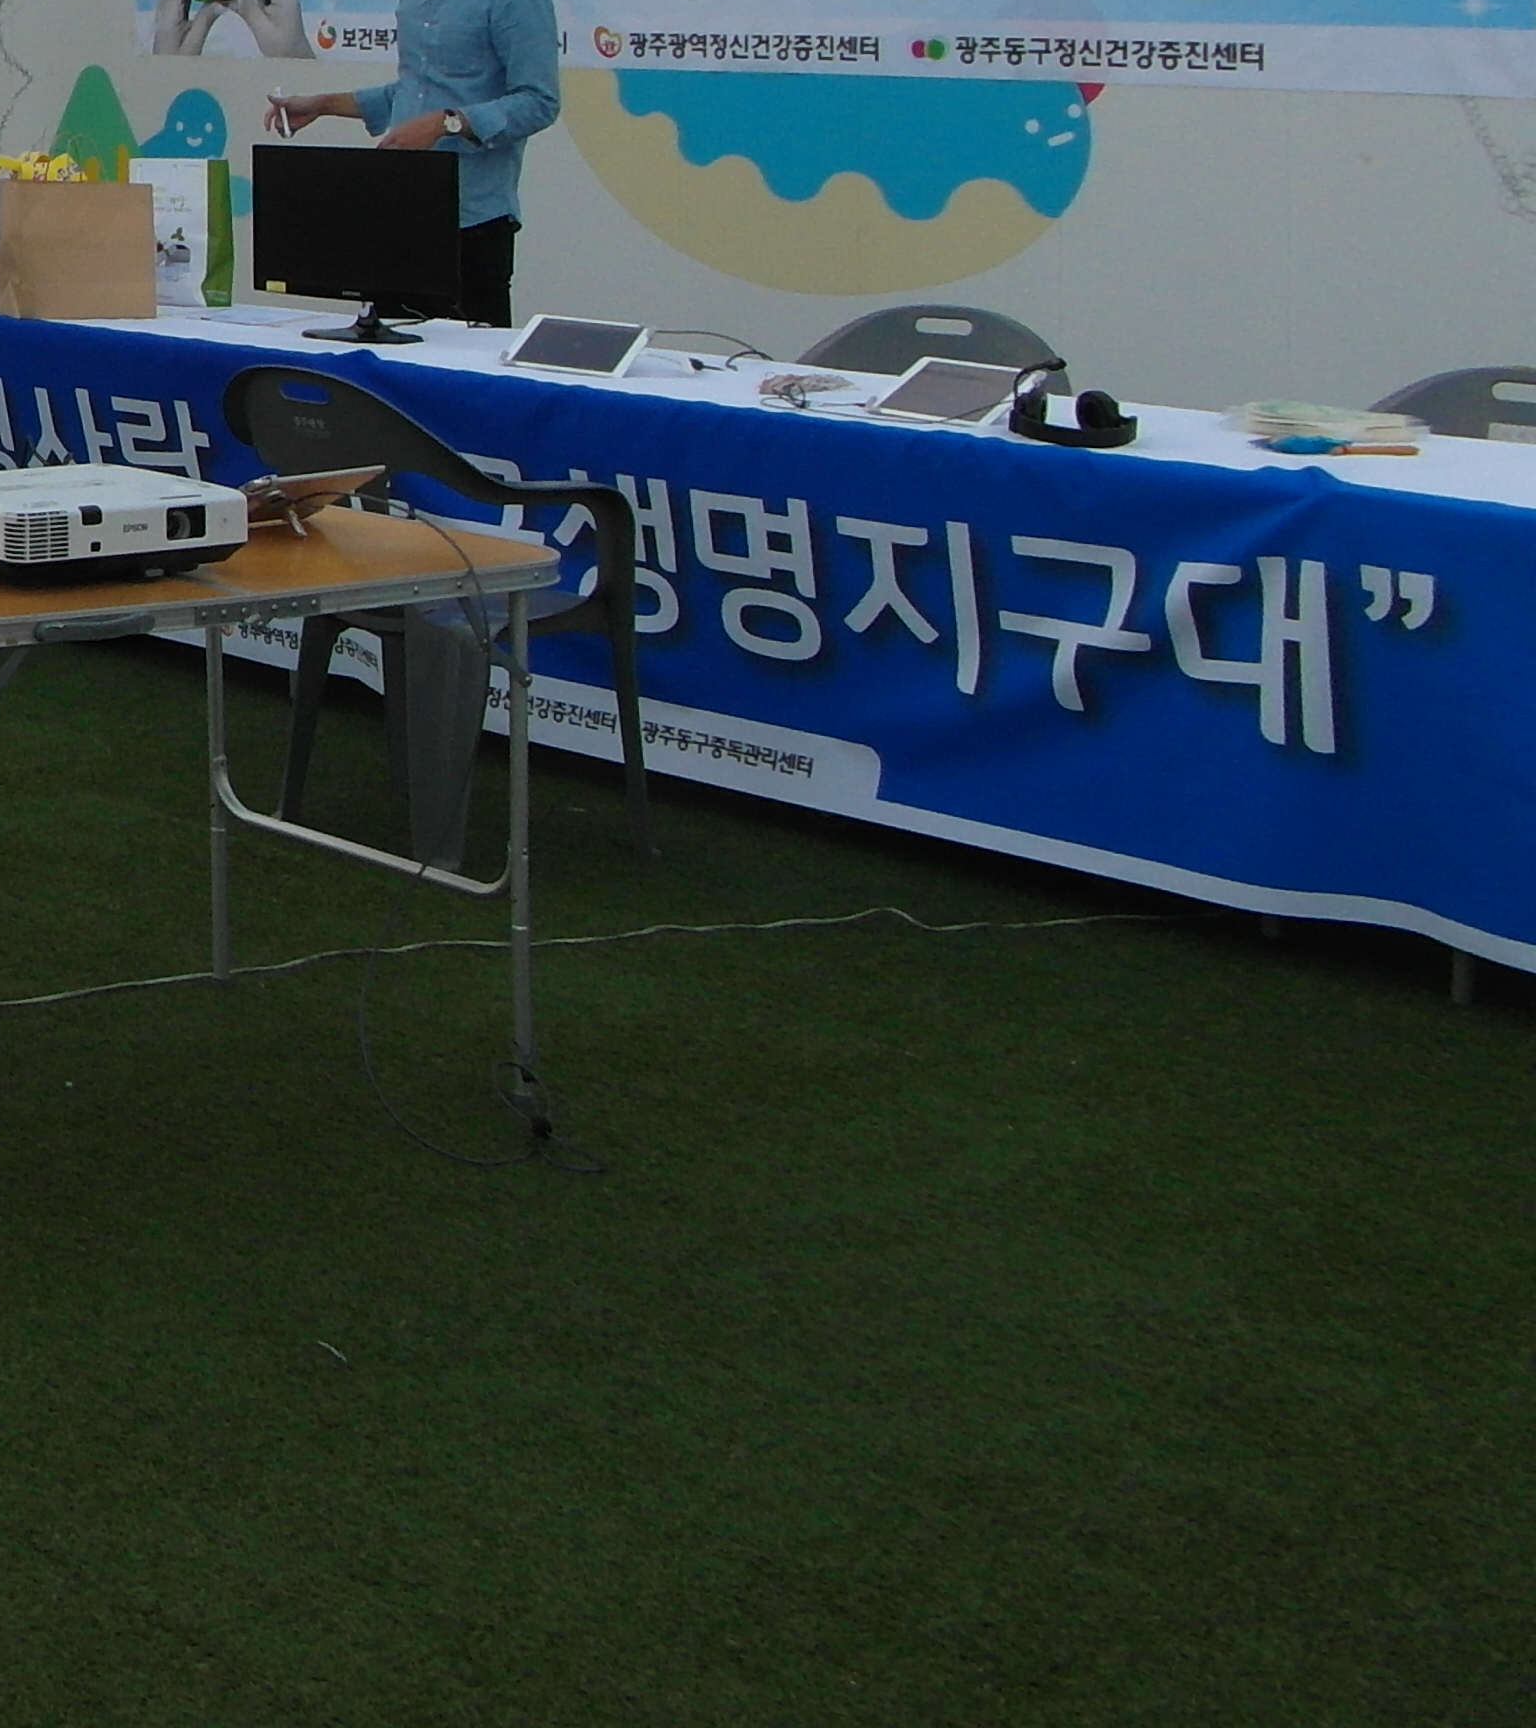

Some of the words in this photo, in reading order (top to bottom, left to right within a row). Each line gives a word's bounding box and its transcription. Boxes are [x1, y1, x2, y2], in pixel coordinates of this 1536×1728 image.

[628, 30, 881, 65] 광주광역정신건강증진센터
[954, 35, 1267, 73] 광주동구정신건강증진센터
[122, 523, 149, 534] EPSON
[642, 720, 815, 779] 광주동구중독관리센터
